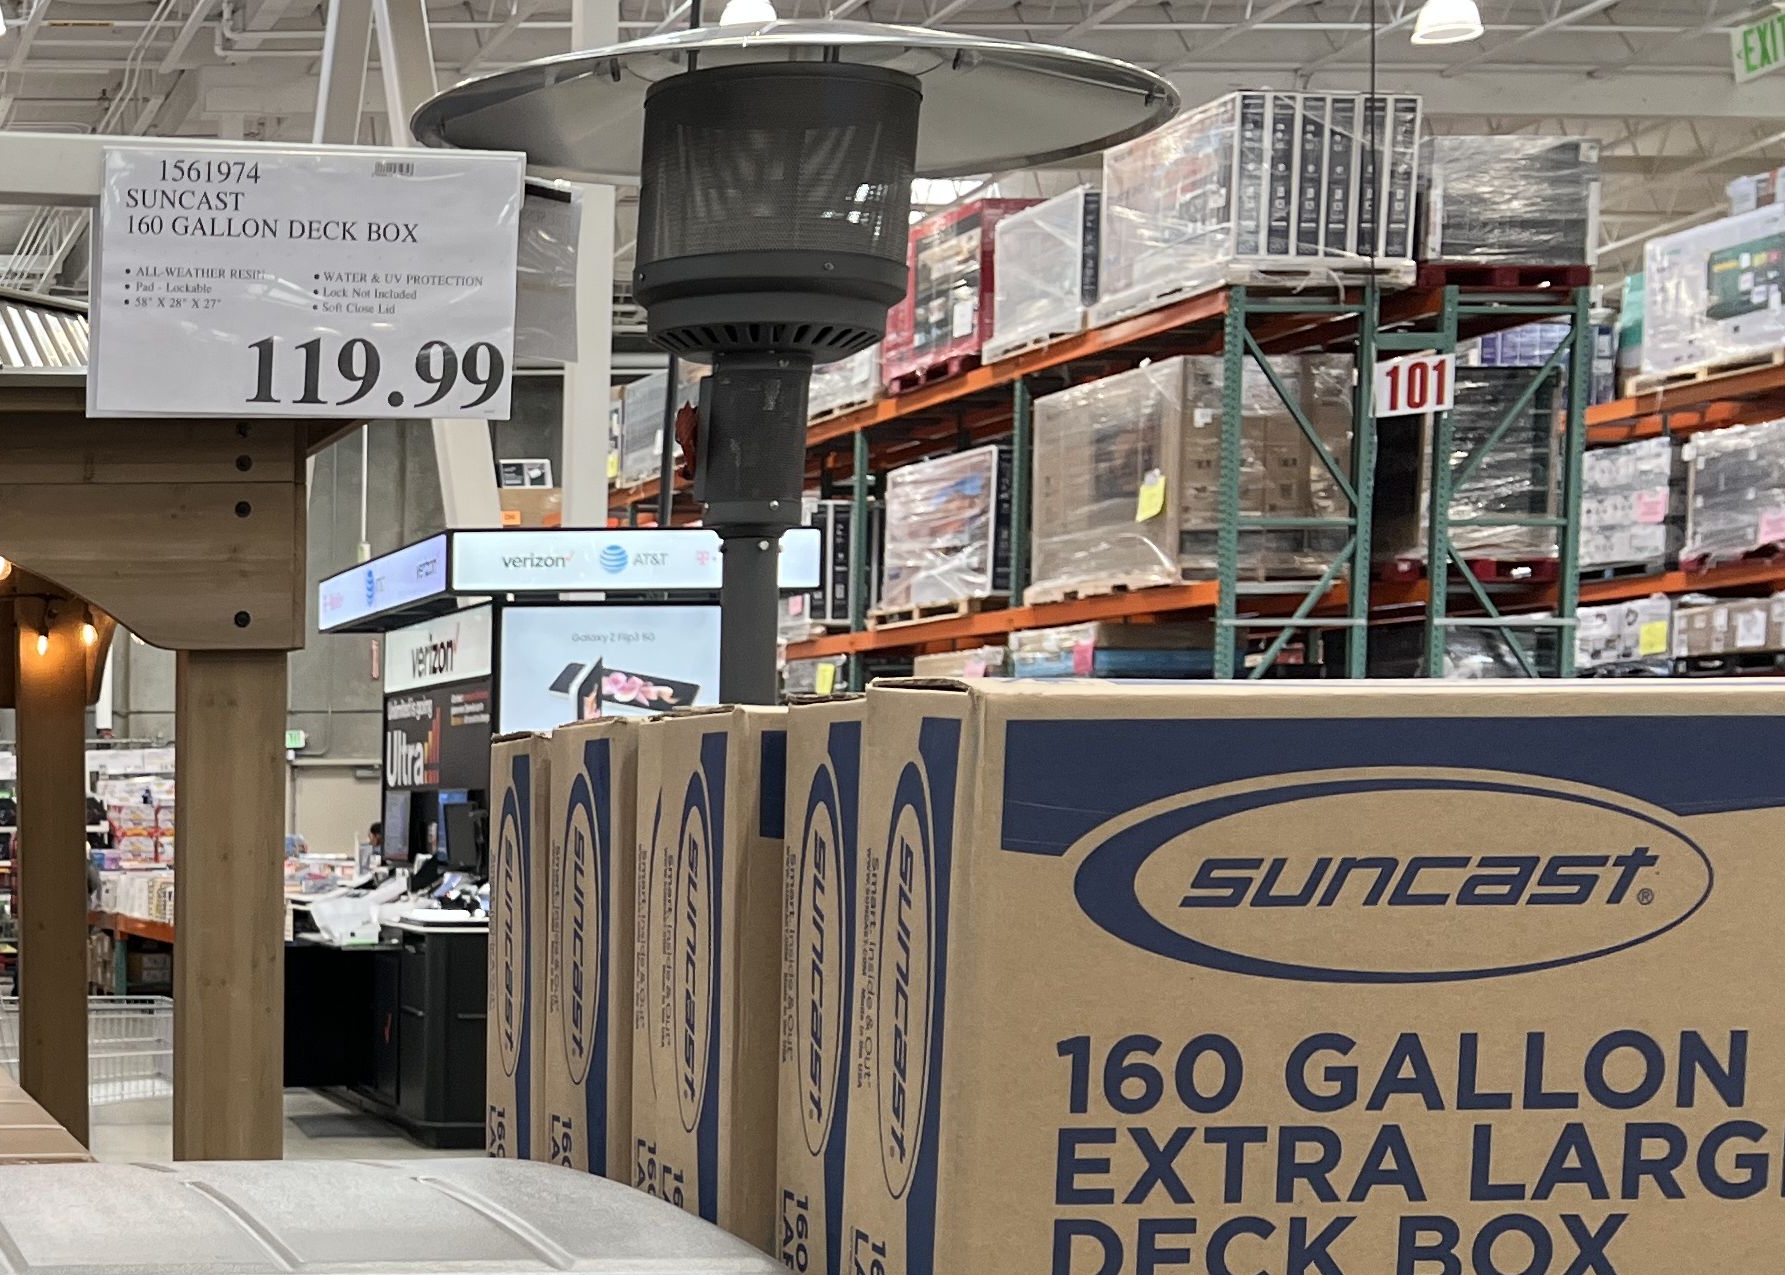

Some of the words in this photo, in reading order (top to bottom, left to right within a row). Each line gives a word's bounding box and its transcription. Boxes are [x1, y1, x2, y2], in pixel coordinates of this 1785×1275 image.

[159, 159, 261, 184] 1561974
[126, 188, 246, 212] SUNCAST
[127, 216, 164, 236] 160
[171, 217, 279, 239] GALLON
[288, 220, 358, 242] DECK
[366, 222, 420, 244] BOX
[135, 281, 155, 294] Pad
[166, 282, 213, 295] Lockable
[157, 297, 166, 308] X
[191, 298, 200, 309] X
[322, 286, 348, 298] Lock
[352, 287, 371, 299] Not
[374, 288, 418, 301] Included
[323, 272, 367, 284] WATER
[371, 273, 381, 284] &
[384, 273, 403, 285] UV
[406, 274, 484, 287] PROTECTION
[322, 301, 344, 313] Soft
[378, 303, 396, 315] Lid
[245, 336, 505, 410] 119.99
[1384, 358, 1449, 413] 101
[501, 552, 567, 569] verizon
[632, 551, 670, 568] AT&T
[411, 633, 455, 679] verizon
[386, 730, 425, 787] Ultra
[1179, 847, 1660, 908] suncast
[571, 826, 586, 1059] suncast
[683, 831, 700, 1104] suncast
[810, 829, 827, 1124] suncast
[891, 836, 915, 1164] suncast
[1056, 1033, 1245, 1116] 160
[1284, 1030, 1749, 1113] GALLON
[1054, 1124, 1428, 1206] EXTRA
[1469, 1119, 1785, 1202] LARG
[794, 1194, 809, 1274] 160
